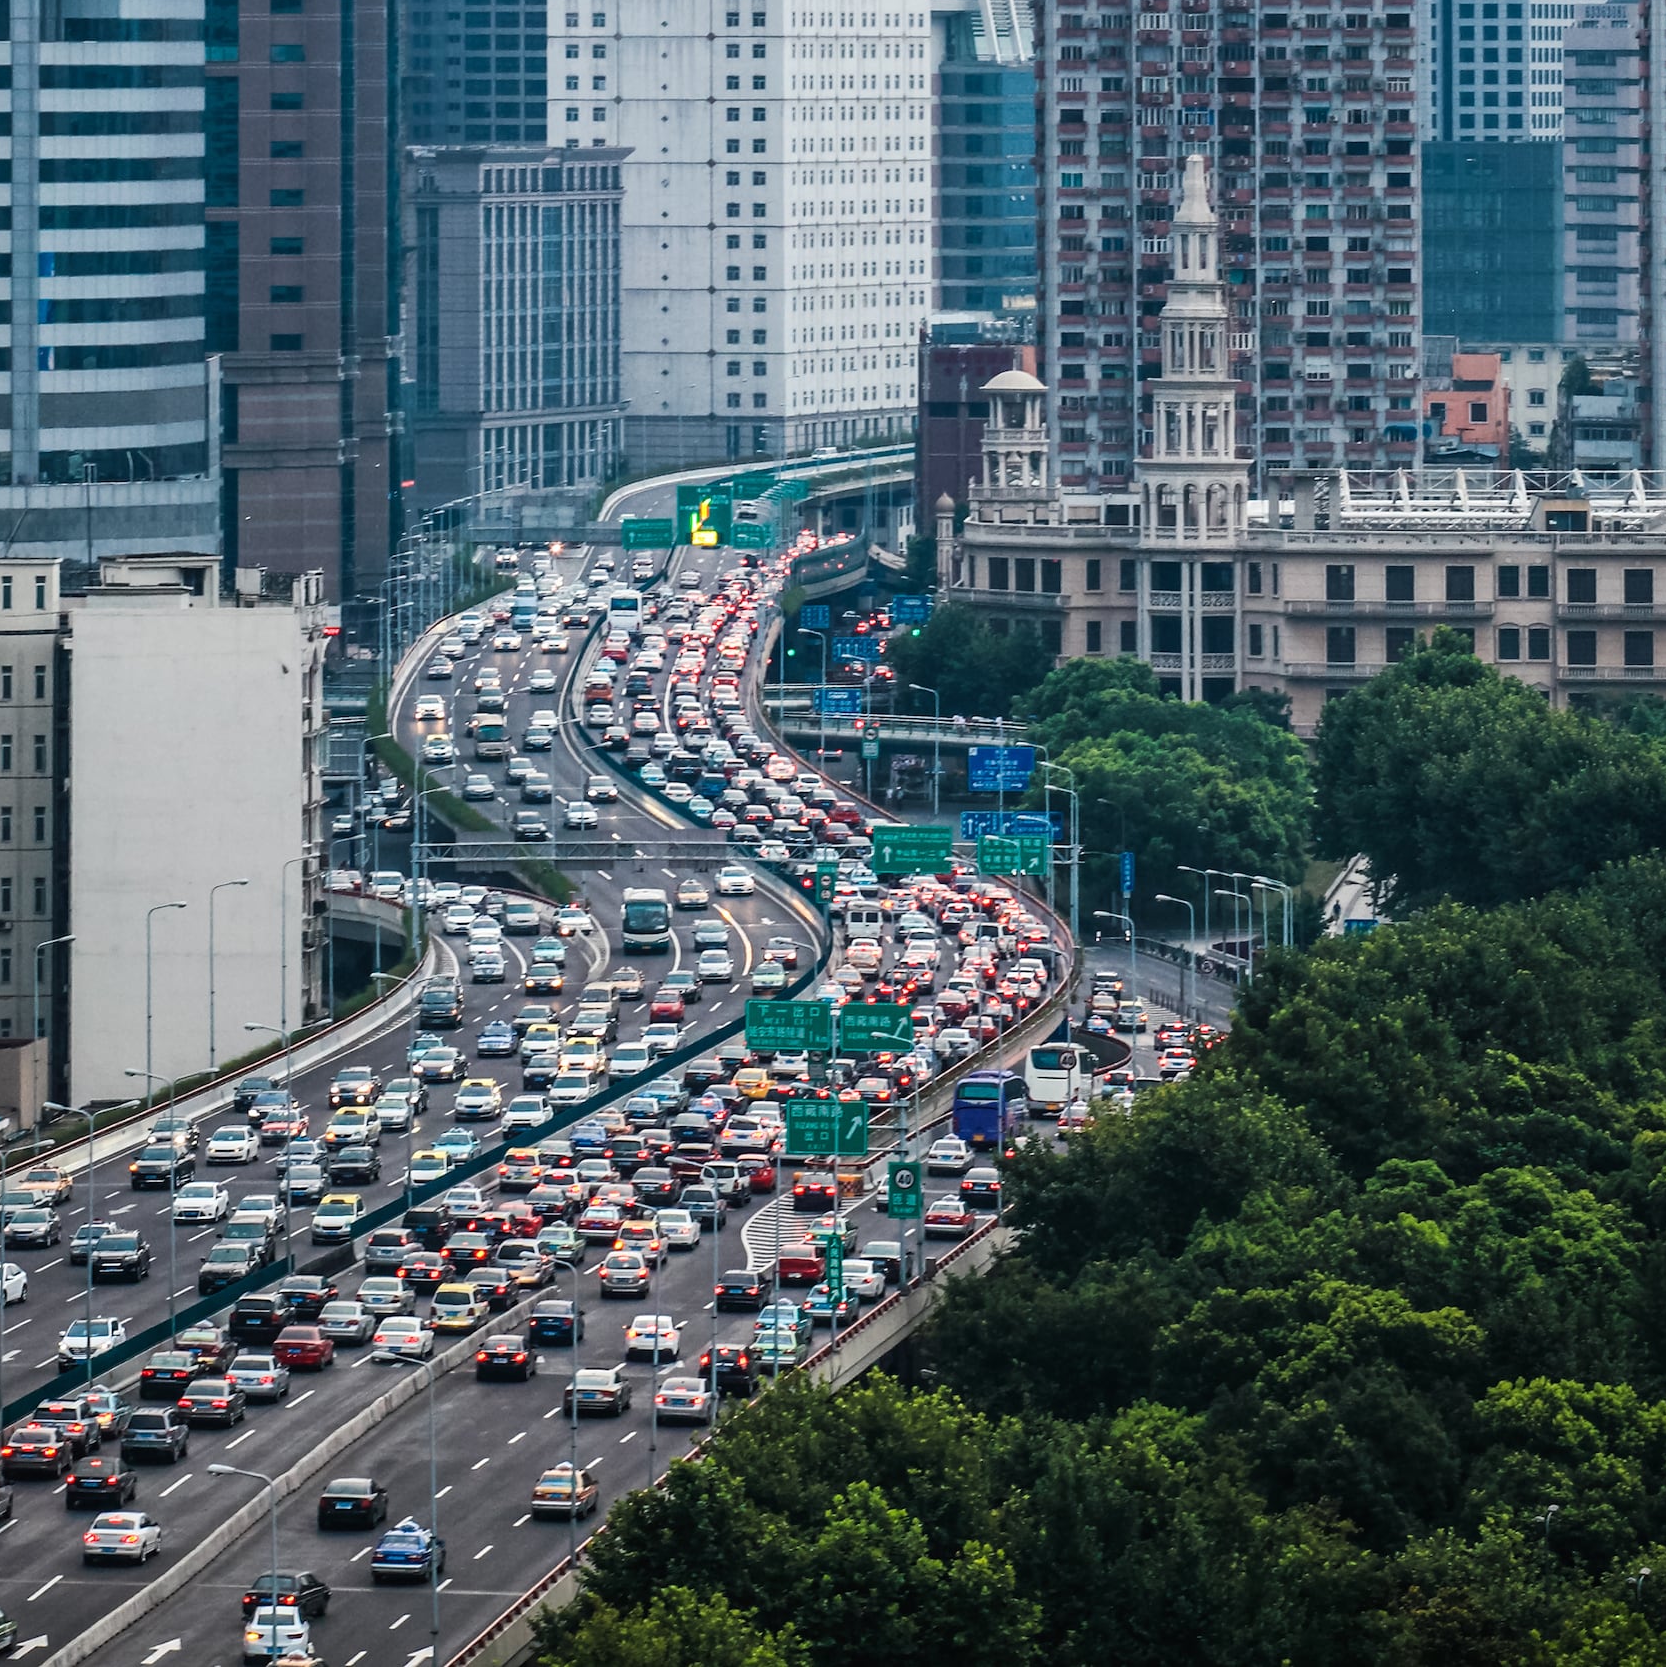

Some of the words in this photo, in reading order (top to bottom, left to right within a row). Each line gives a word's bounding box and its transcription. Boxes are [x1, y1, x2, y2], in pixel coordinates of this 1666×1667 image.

[757, 1004, 820, 1017] 下一出口
[844, 1015, 892, 1028] 西藏南路
[1062, 1055, 1073, 1065] 40
[791, 1104, 844, 1118] 西藏南路
[804, 1131, 830, 1142] 出口
[898, 1174, 912, 1185] 40
